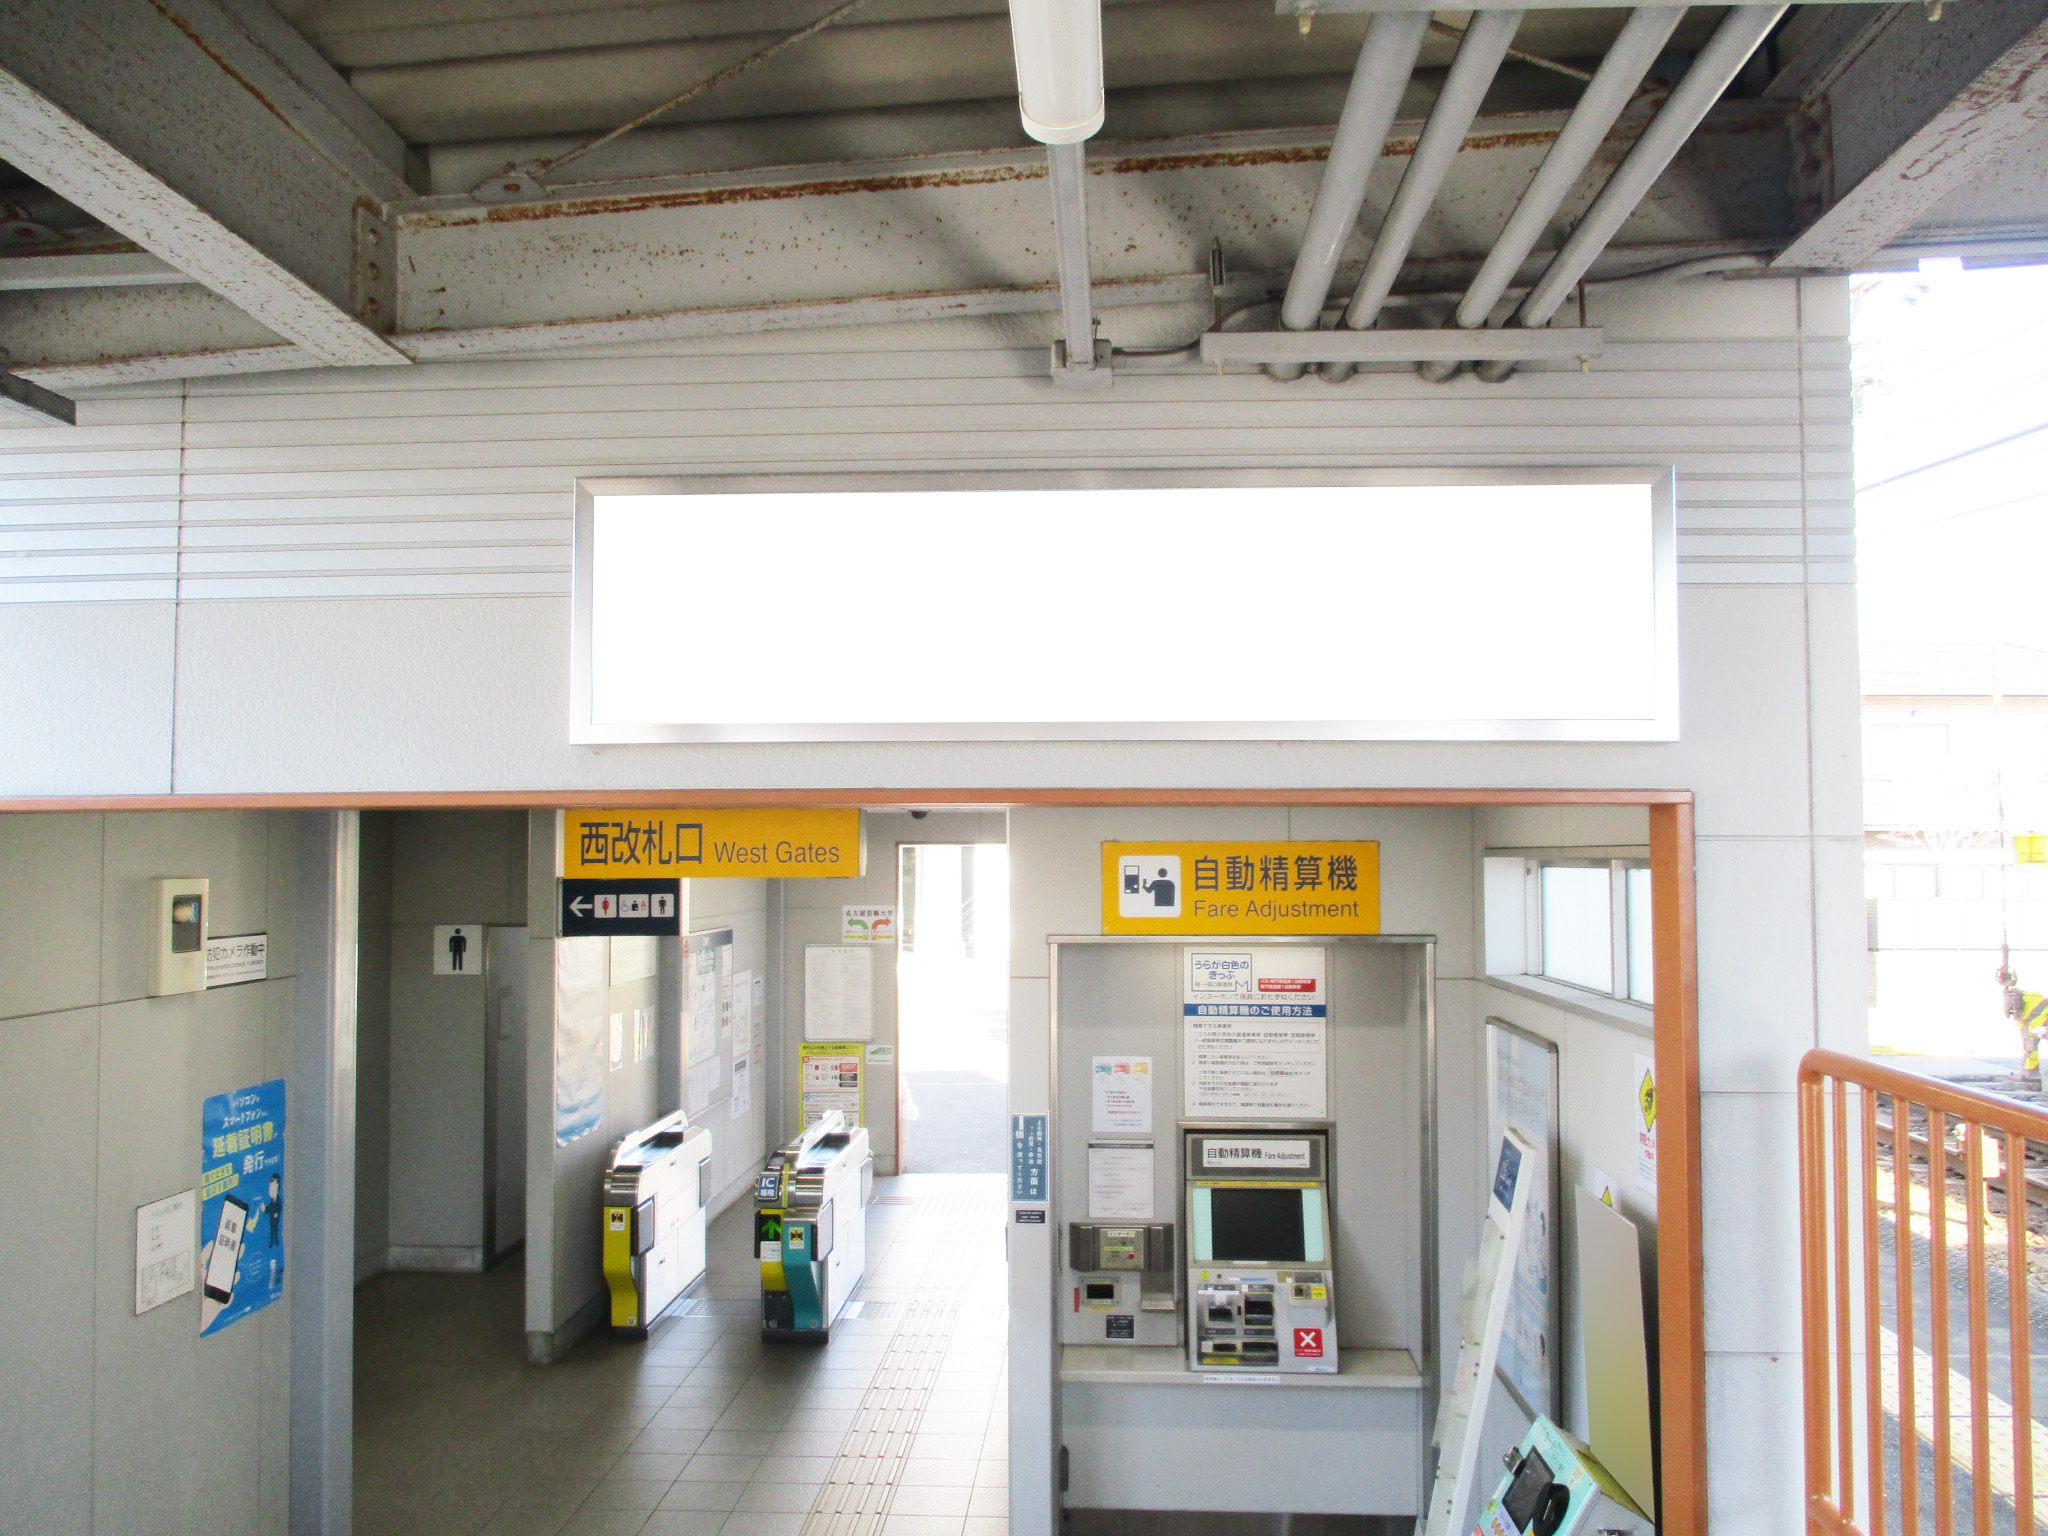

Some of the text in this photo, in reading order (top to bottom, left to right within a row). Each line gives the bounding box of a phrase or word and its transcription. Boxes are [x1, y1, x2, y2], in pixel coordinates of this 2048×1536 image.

[580, 820, 840, 866] 西改札口 West Gates
[1194, 854, 1358, 892] 自動精算機
[845, 909, 894, 917] 名古屋芸術大学
[1194, 900, 1359, 922] Fare Adjustment
[1194, 960, 1250, 970] うらが白色の
[1208, 970, 1236, 980] きっぷ
[1192, 993, 1315, 1001] インターホンで係員におたずねください
[1198, 1005, 1313, 1016] 自動精算機のご使用方法
[1207, 1147, 1305, 1161] 自動精算機 Fare Adjustment
[761, 1177, 776, 1187] IC
[1030, 1168, 1039, 1195] 方面は
